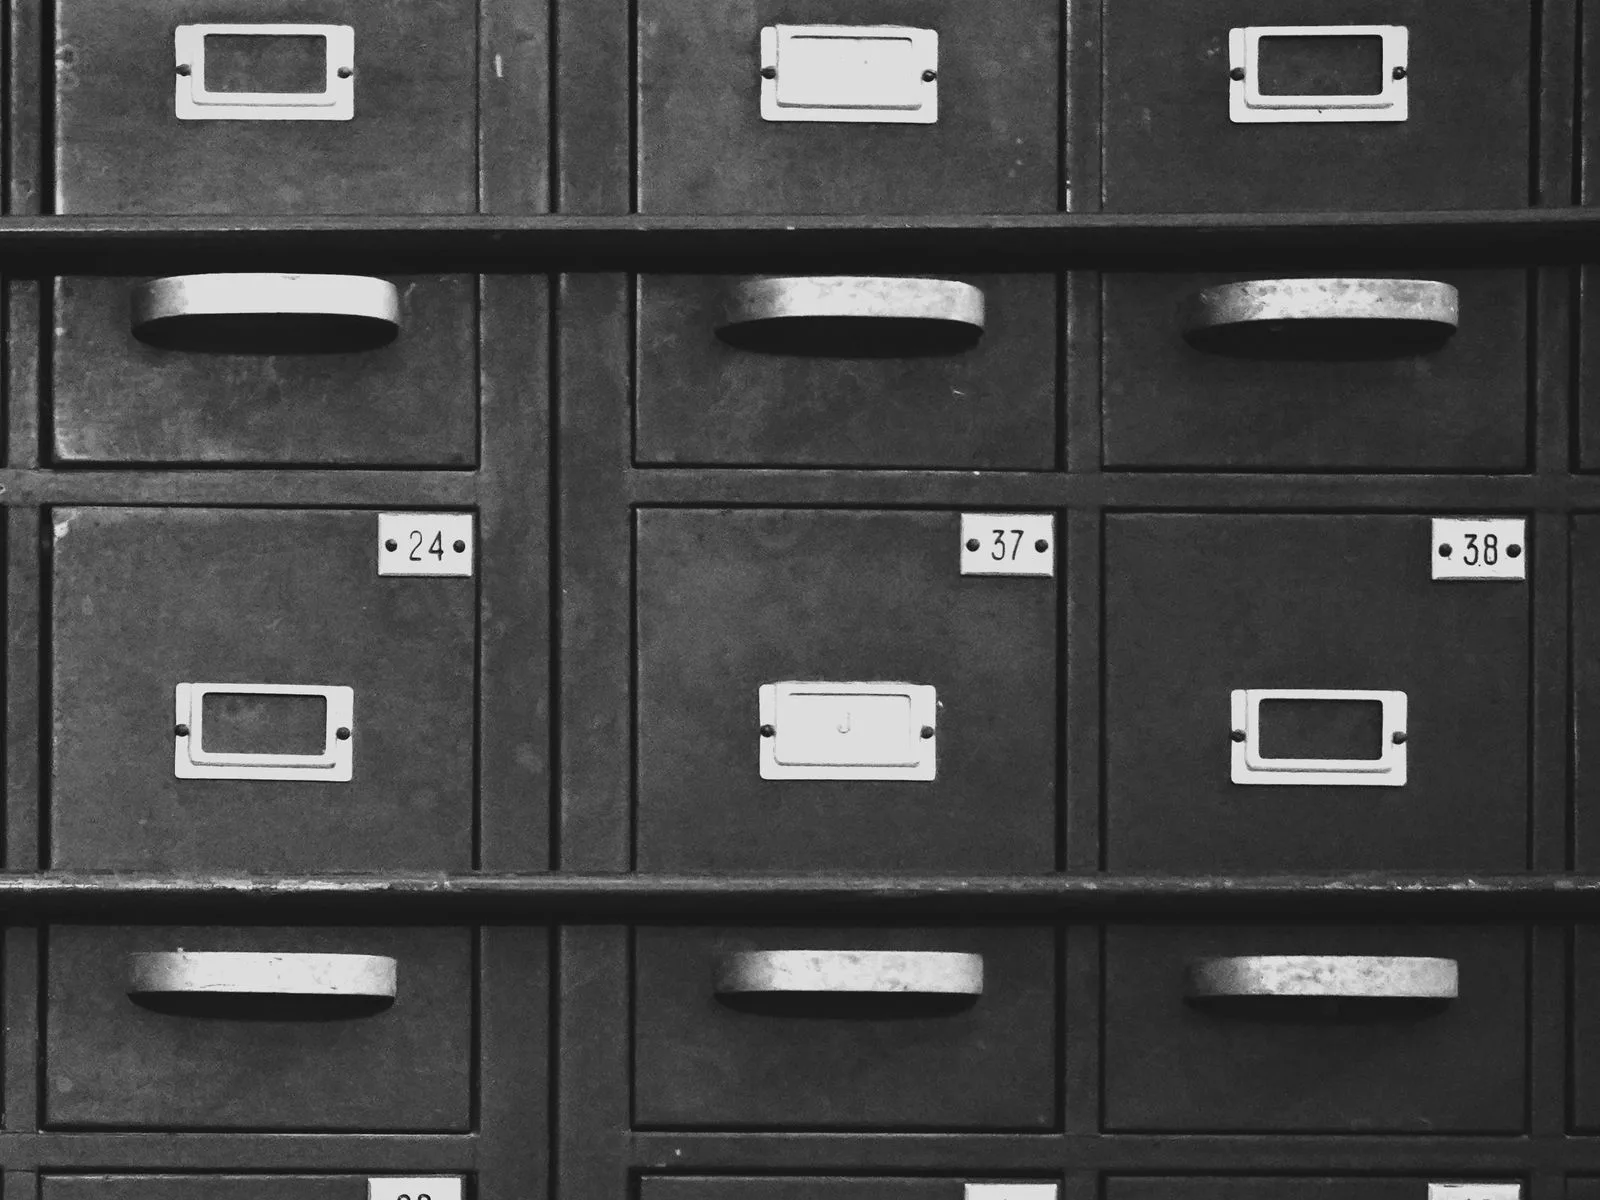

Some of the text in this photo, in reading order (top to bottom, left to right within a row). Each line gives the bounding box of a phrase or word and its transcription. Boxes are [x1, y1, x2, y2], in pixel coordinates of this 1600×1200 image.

[409, 530, 443, 562] 24
[991, 529, 1023, 561] 37
[1463, 533, 1498, 566] 38
